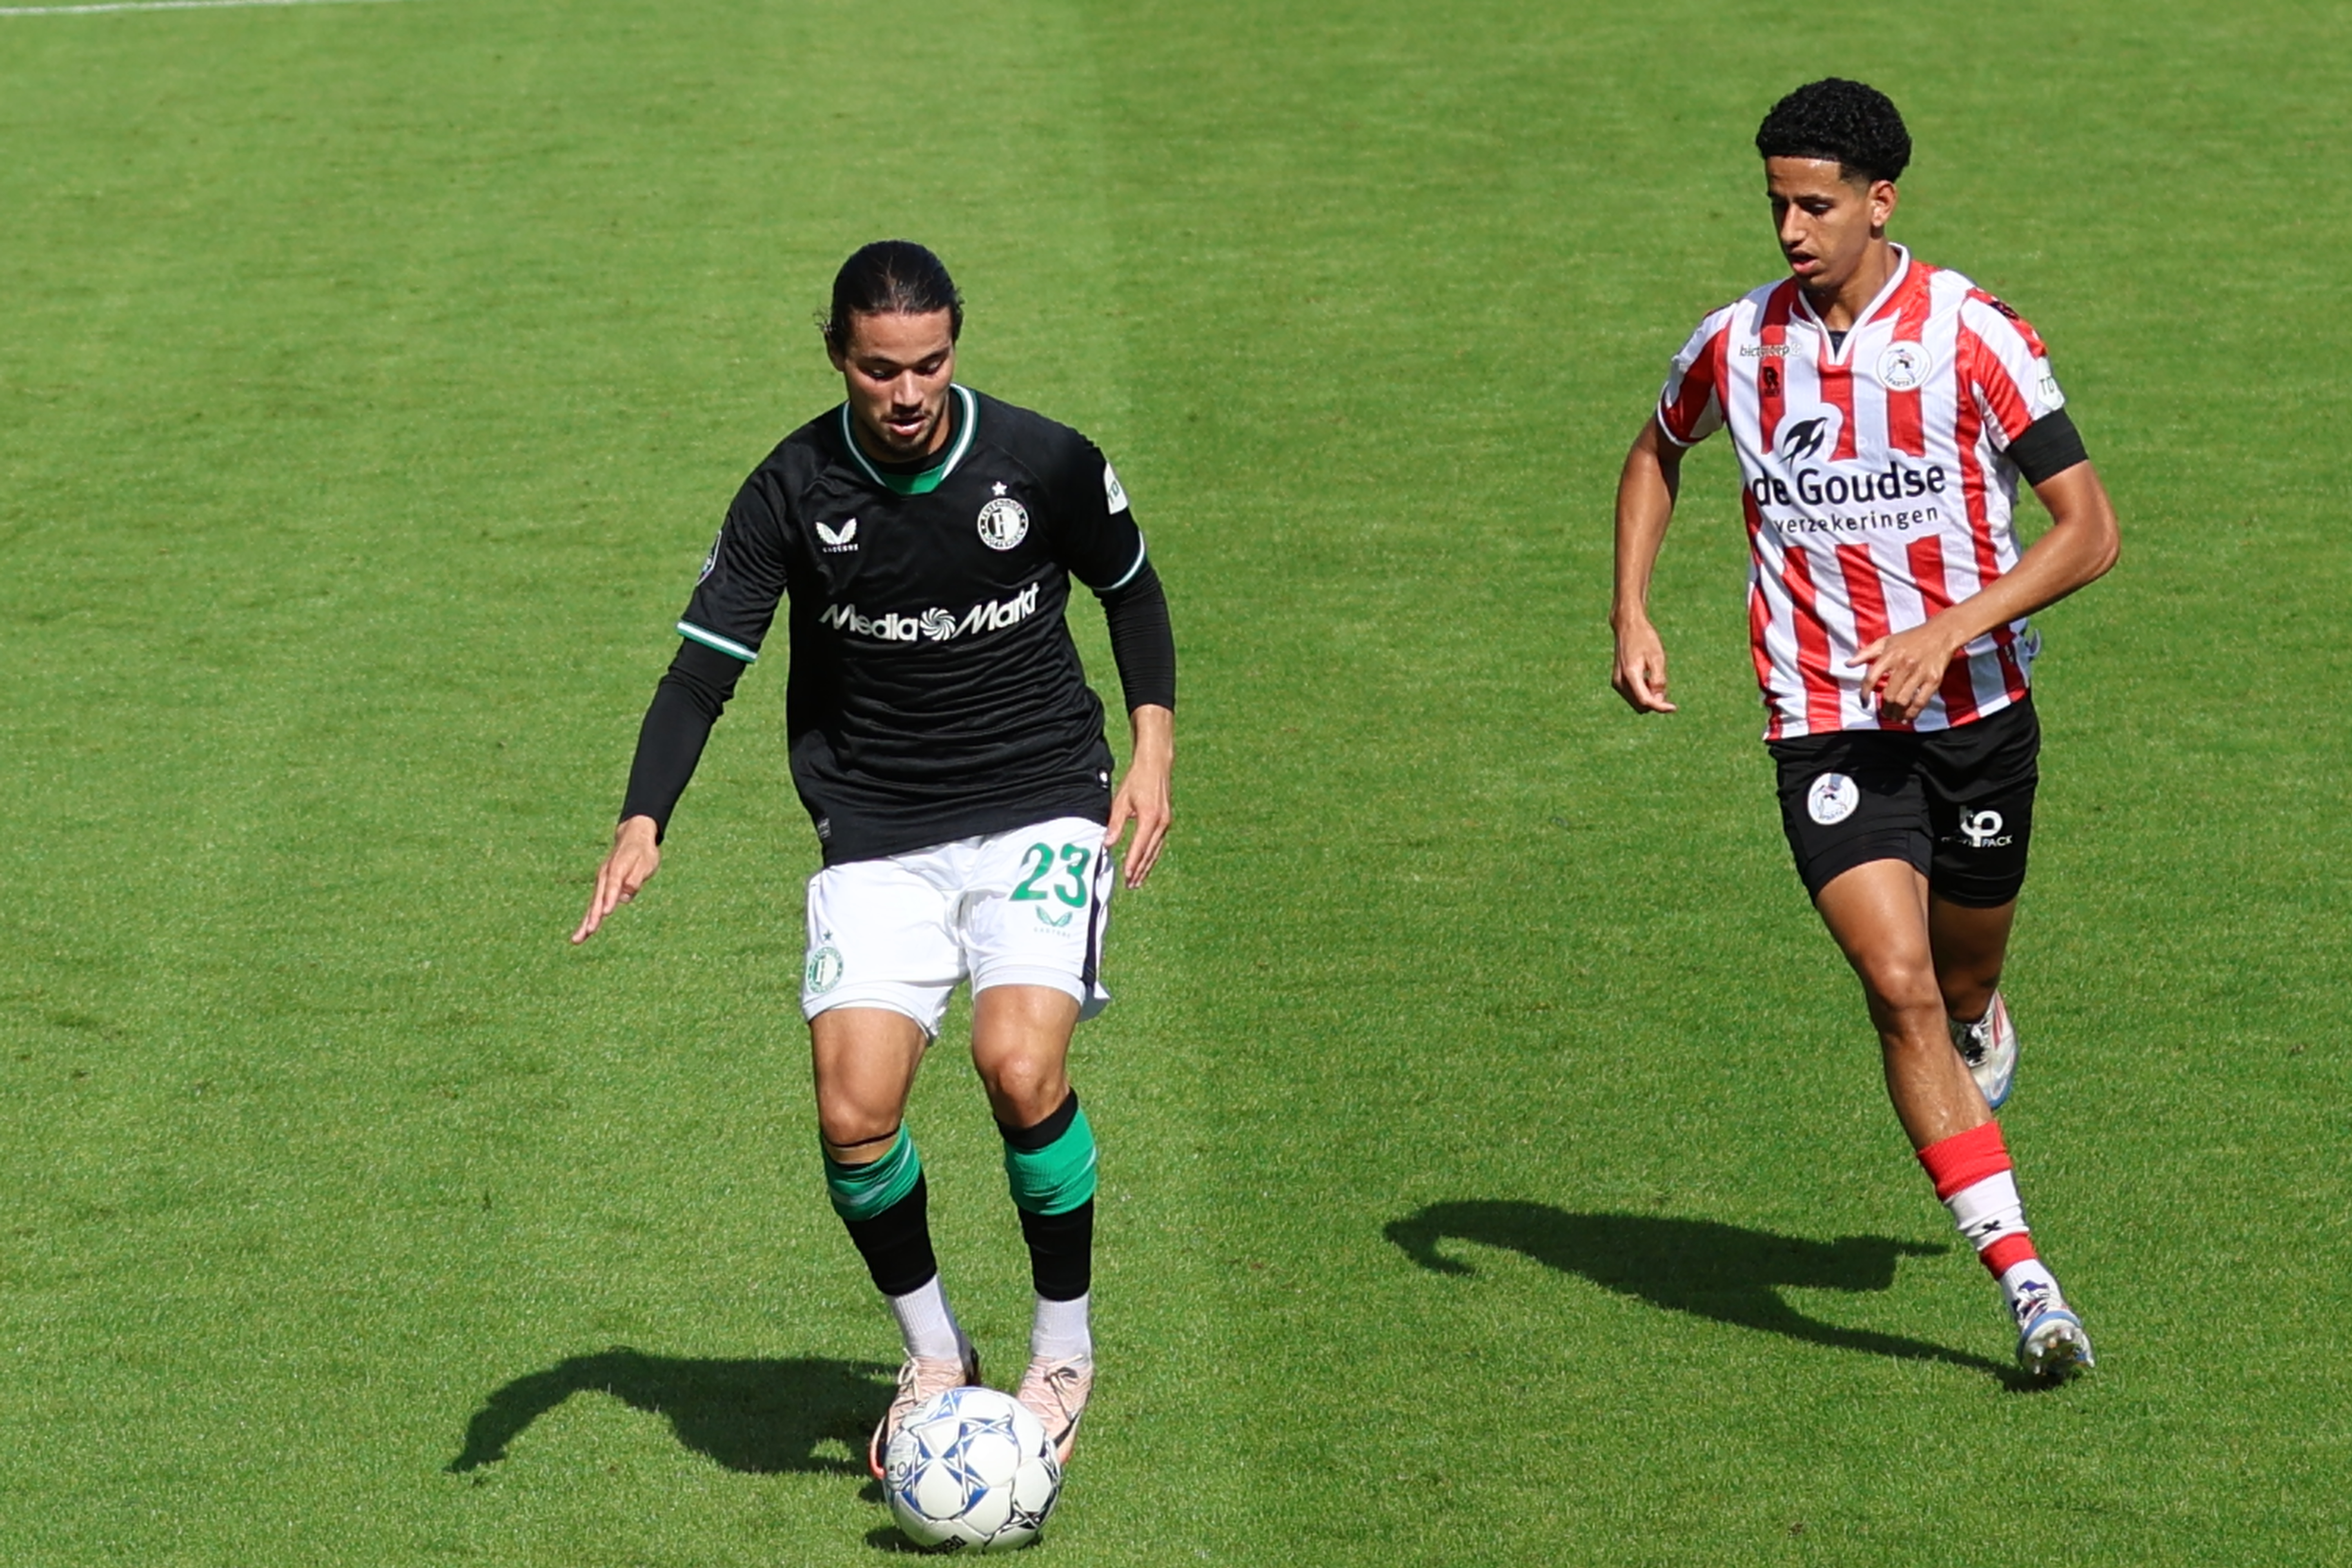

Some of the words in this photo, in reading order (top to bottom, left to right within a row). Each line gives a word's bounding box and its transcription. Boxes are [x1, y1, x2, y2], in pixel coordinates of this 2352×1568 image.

[1752, 464, 1792, 506] de
[1797, 461, 1946, 506] Goudse
[1773, 506, 1938, 533] verzekeringen
[818, 603, 918, 641] Media
[951, 582, 1039, 639] Markt
[1008, 842, 1091, 909] 23
